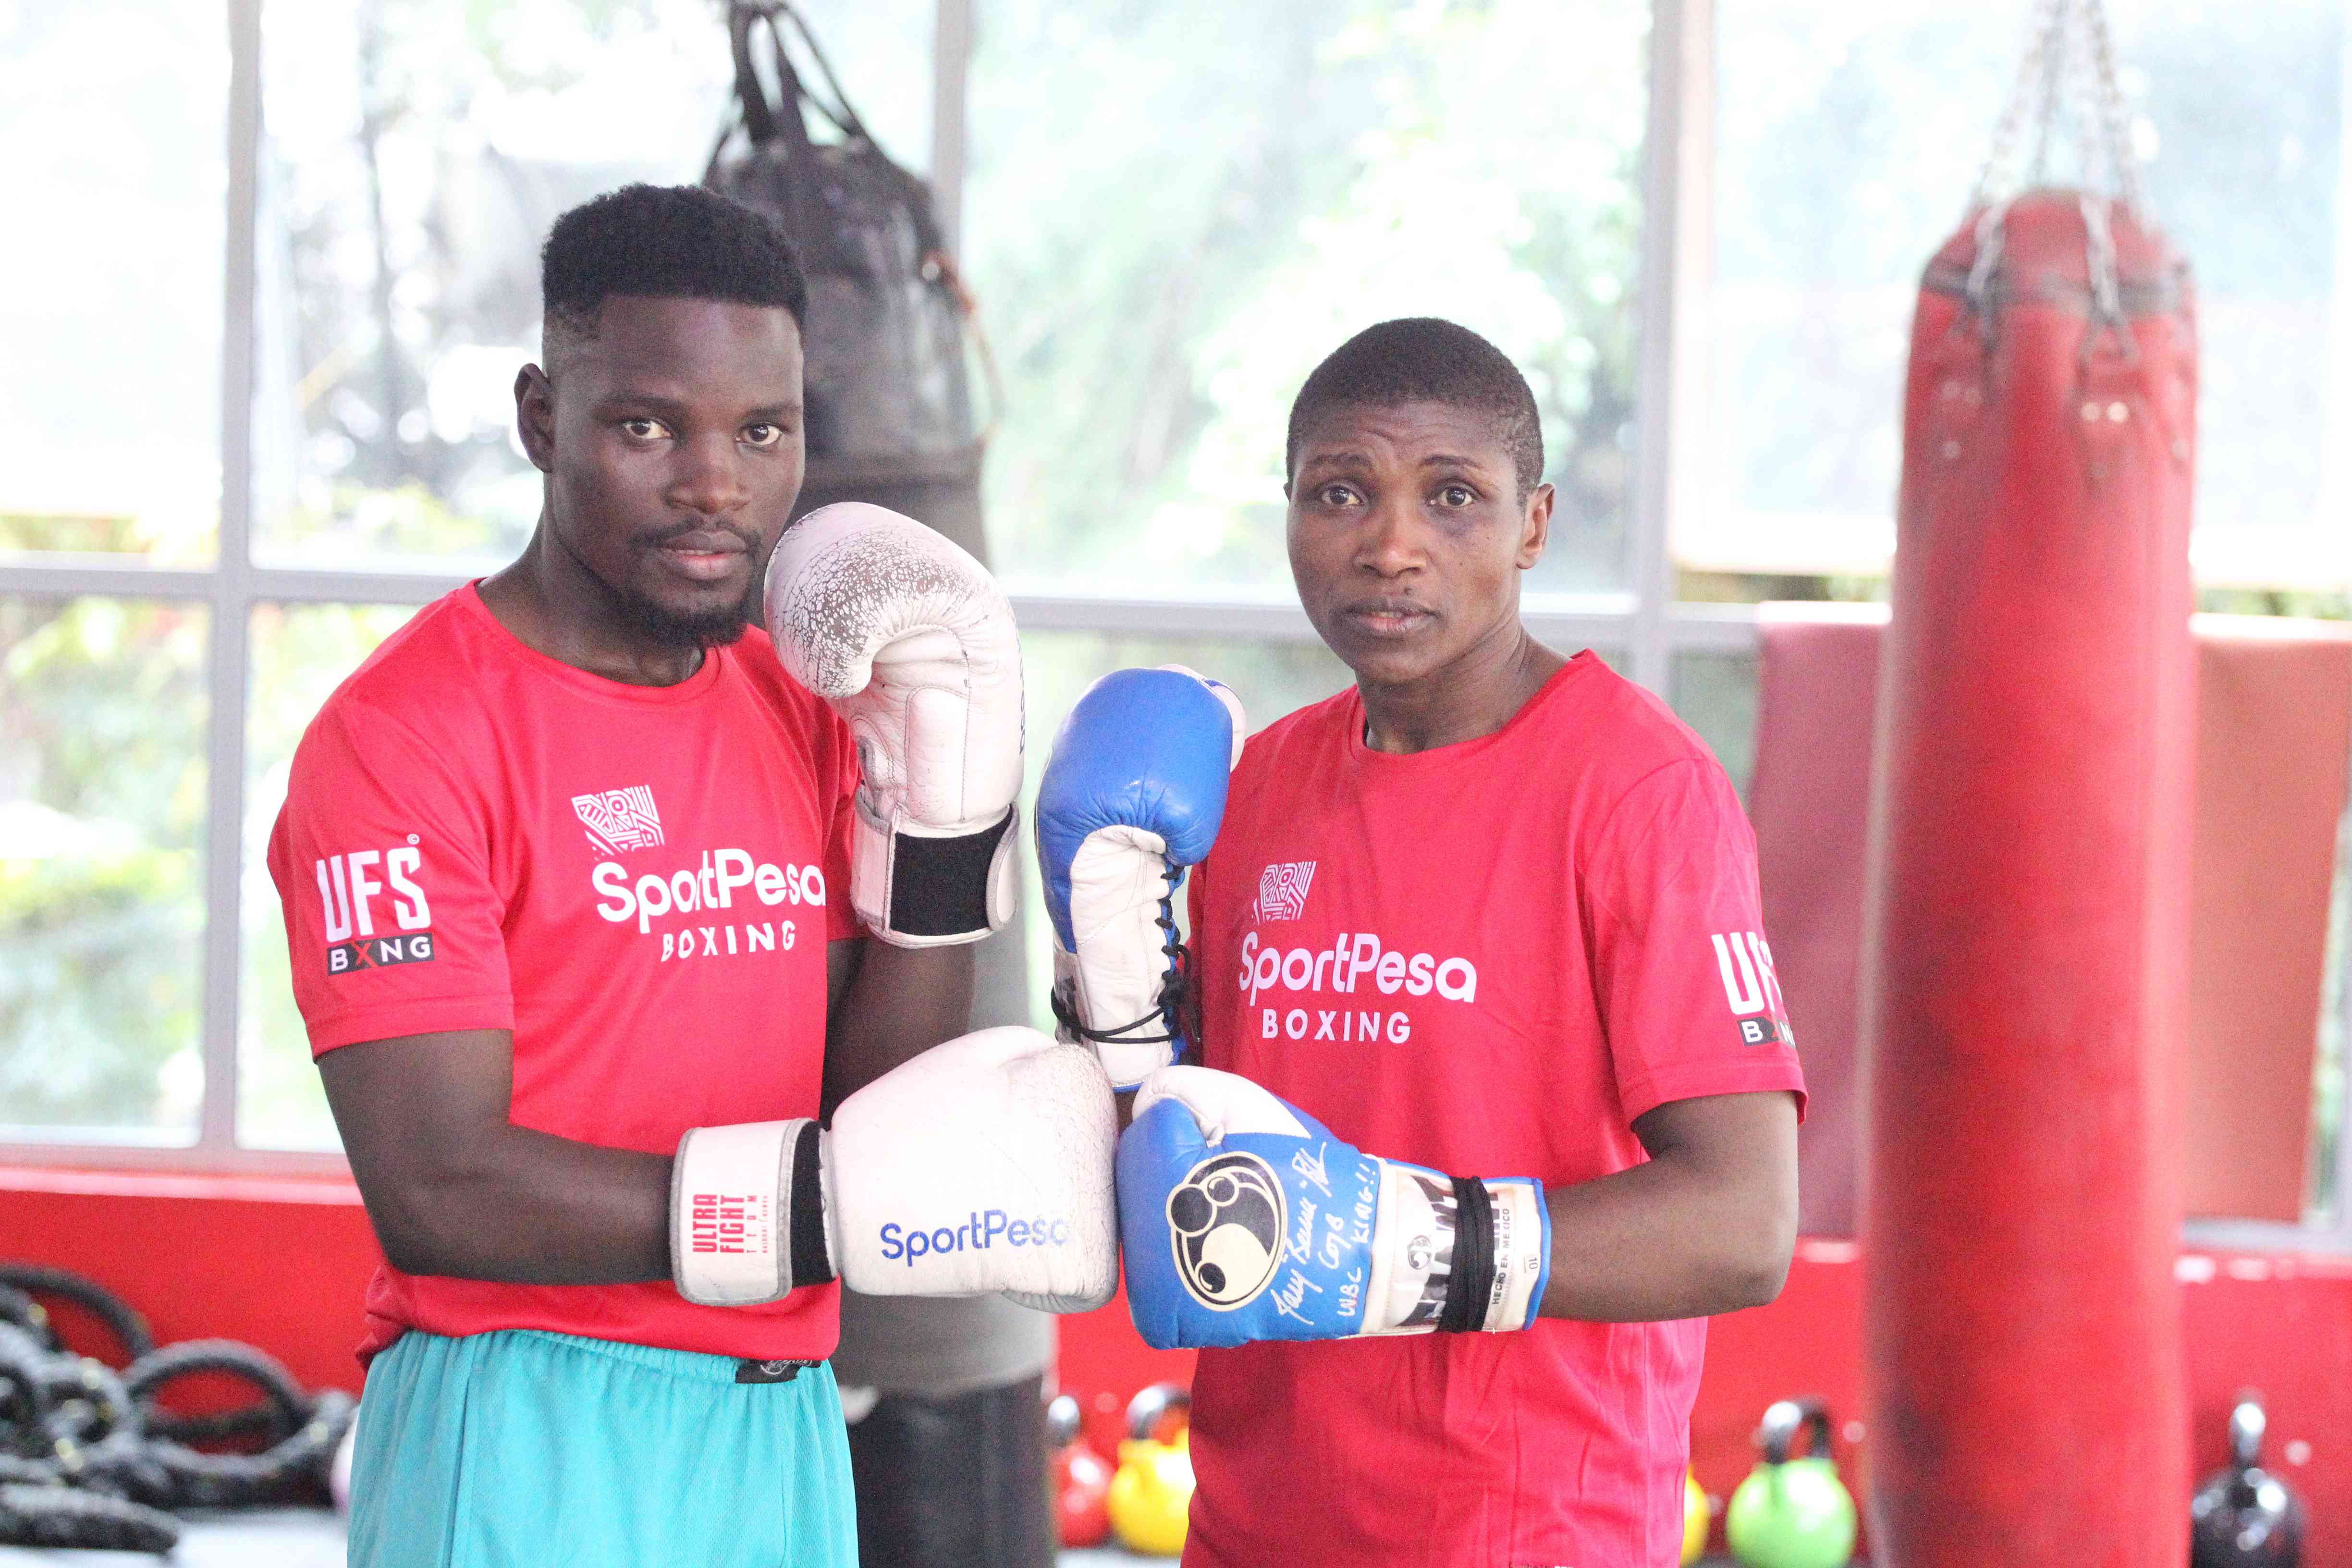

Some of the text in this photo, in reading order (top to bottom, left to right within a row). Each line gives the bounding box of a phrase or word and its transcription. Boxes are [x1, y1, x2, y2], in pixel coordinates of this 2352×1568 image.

[592, 848, 826, 934] SportPesa
[661, 920, 796, 962] BOXING
[1239, 931, 1477, 1006] SportPesa
[1262, 1009, 1411, 1044] BOXING
[693, 1194, 717, 1252] ULTRA
[719, 1195, 744, 1253] FIGHT
[1337, 1267, 1361, 1317] WBC
